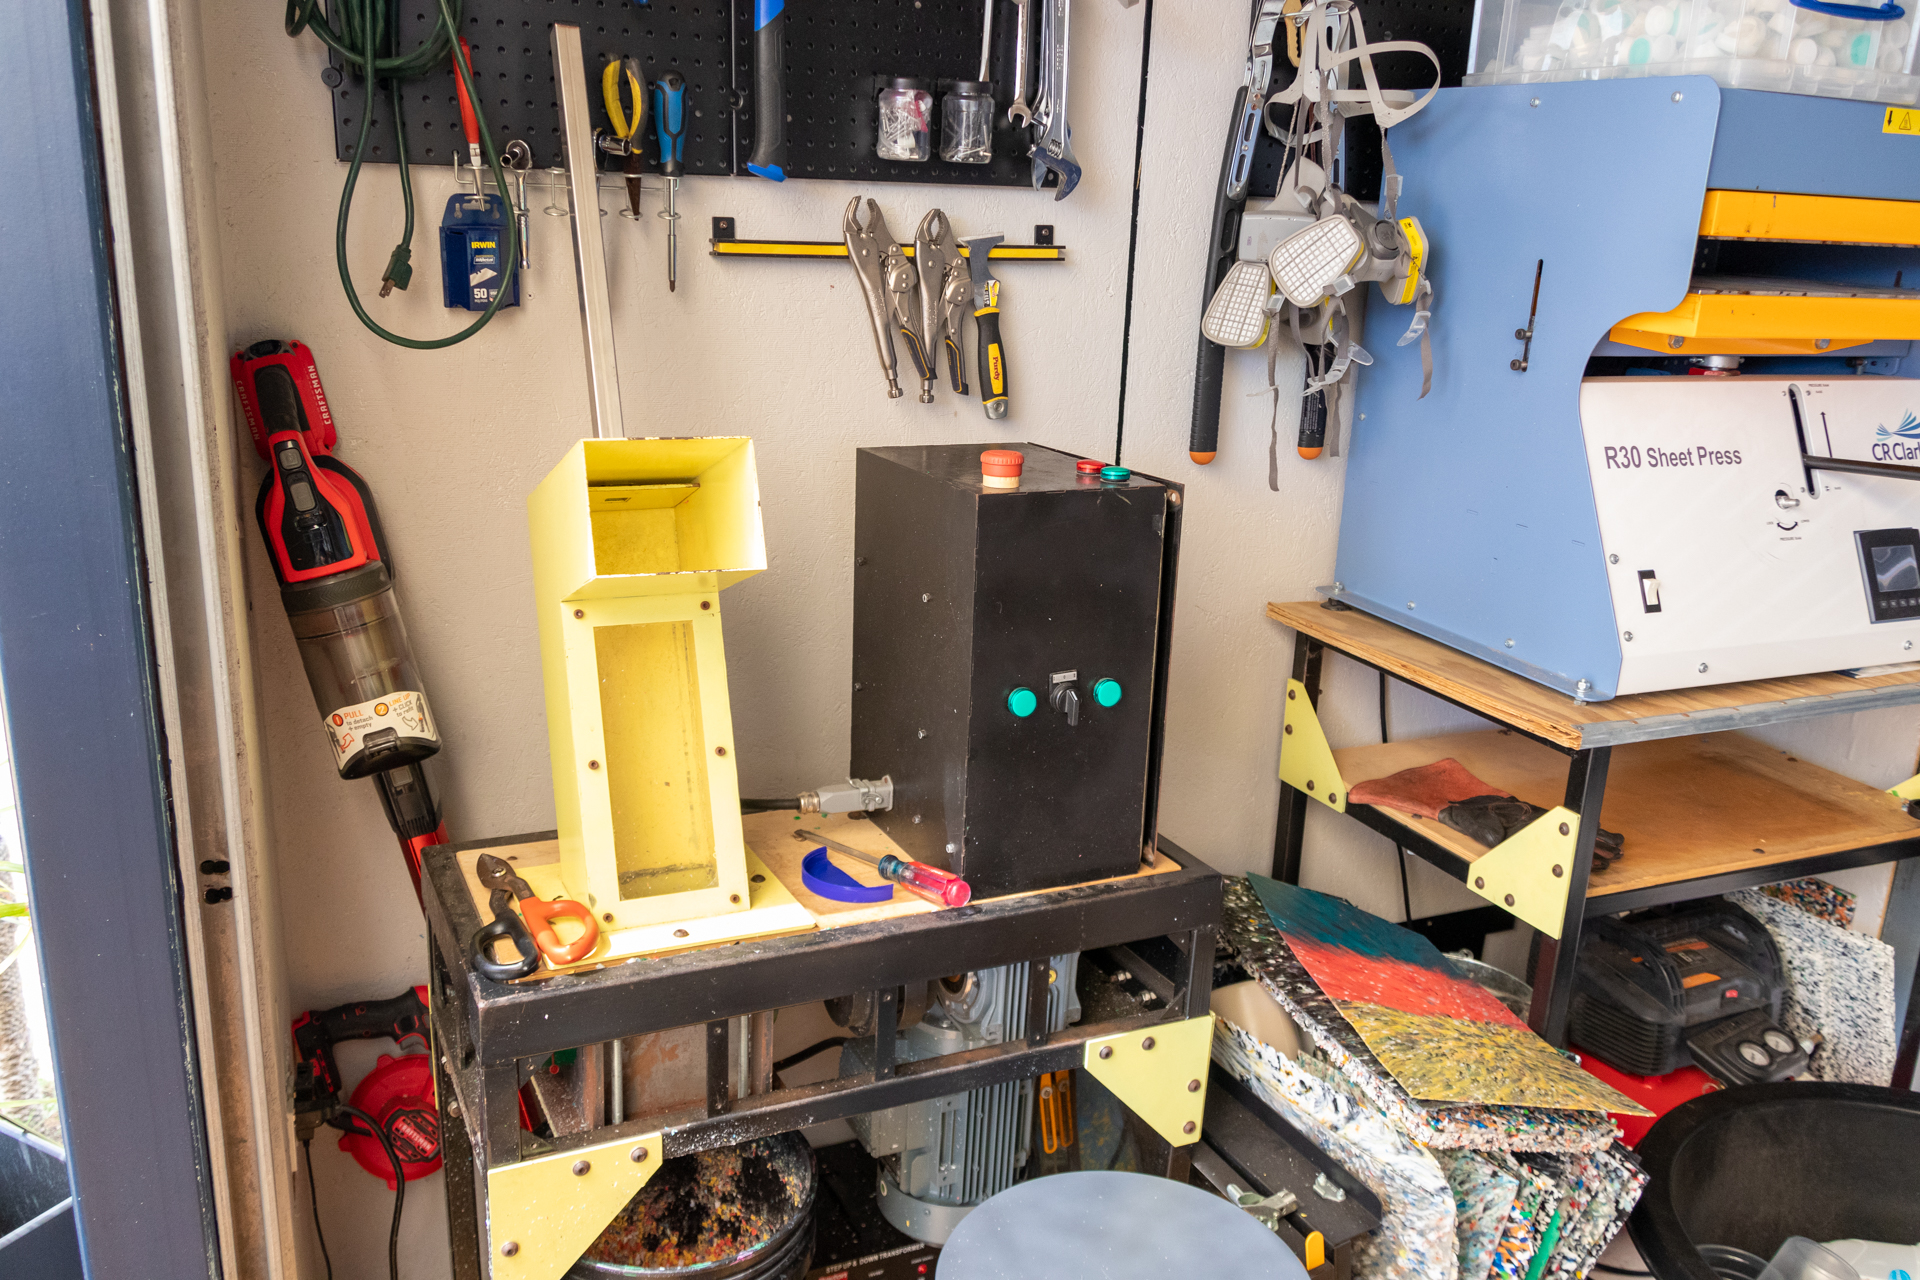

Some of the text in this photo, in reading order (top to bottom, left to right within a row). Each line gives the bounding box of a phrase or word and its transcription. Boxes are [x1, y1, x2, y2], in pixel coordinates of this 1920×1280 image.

[471, 241, 496, 249] IRWIN
[473, 288, 488, 299] 50
[992, 356, 1000, 381] Purdy
[307, 365, 331, 425] CRAFTSMAN
[236, 380, 260, 440] CRAFTSMAN
[1603, 445, 1743, 470] R30 Sheet Press
[1872, 442, 1893, 462] CR
[388, 698, 402, 707] LINE
[403, 693, 411, 701] UP
[343, 710, 364, 720] PULL
[353, 715, 374, 725] detach
[826, 1264, 843, 1273] STEP
[842, 1261, 852, 1270] UP
[859, 1255, 879, 1265] DOWN
[880, 1242, 925, 1259] TRANSFORMER
